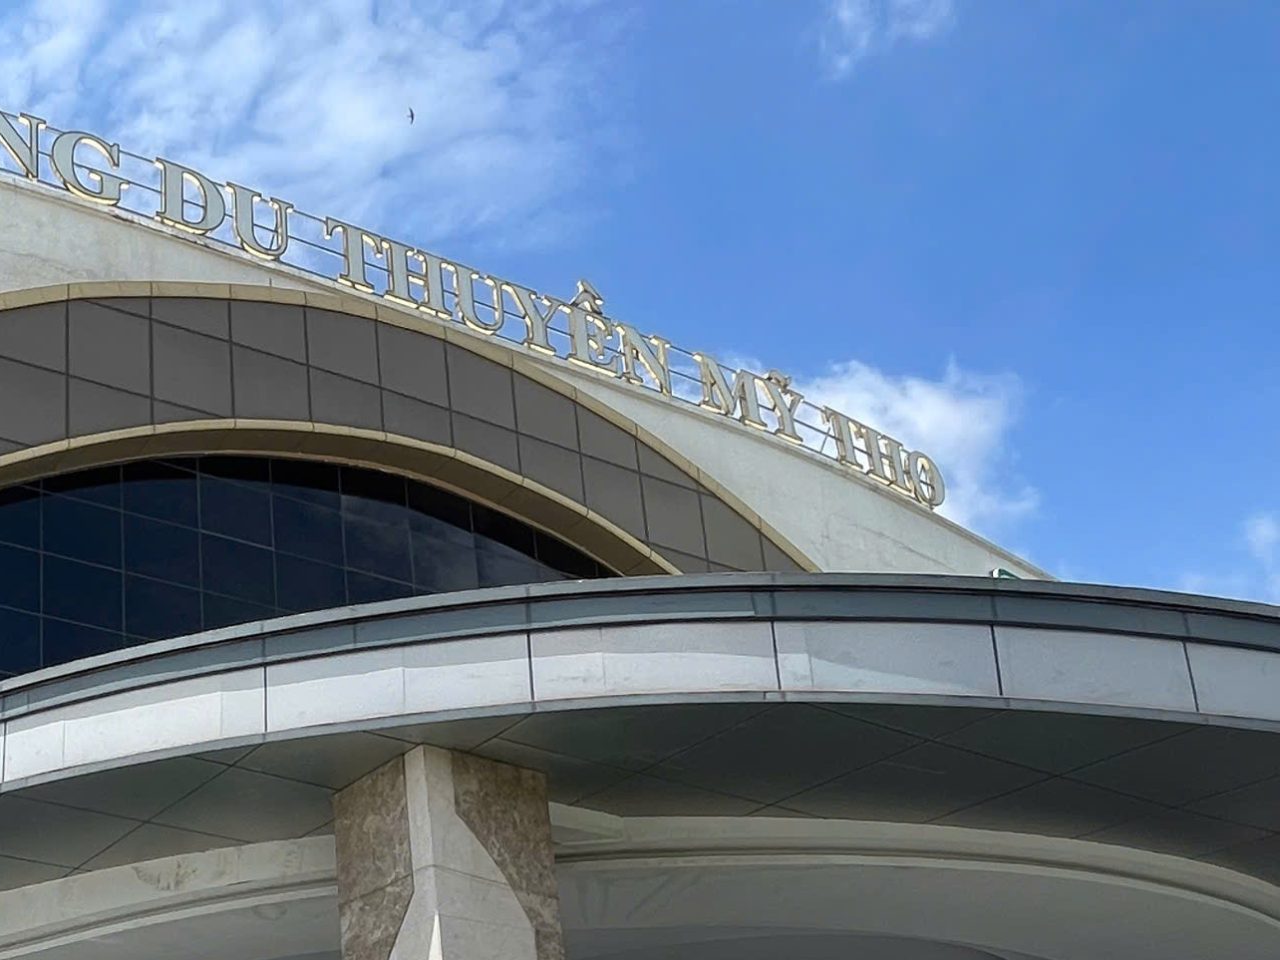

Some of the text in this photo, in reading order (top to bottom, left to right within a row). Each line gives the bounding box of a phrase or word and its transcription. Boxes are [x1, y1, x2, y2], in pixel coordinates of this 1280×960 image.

[154, 156, 293, 261] DU
[692, 351, 805, 443] MỸ
[822, 405, 945, 509] THO
